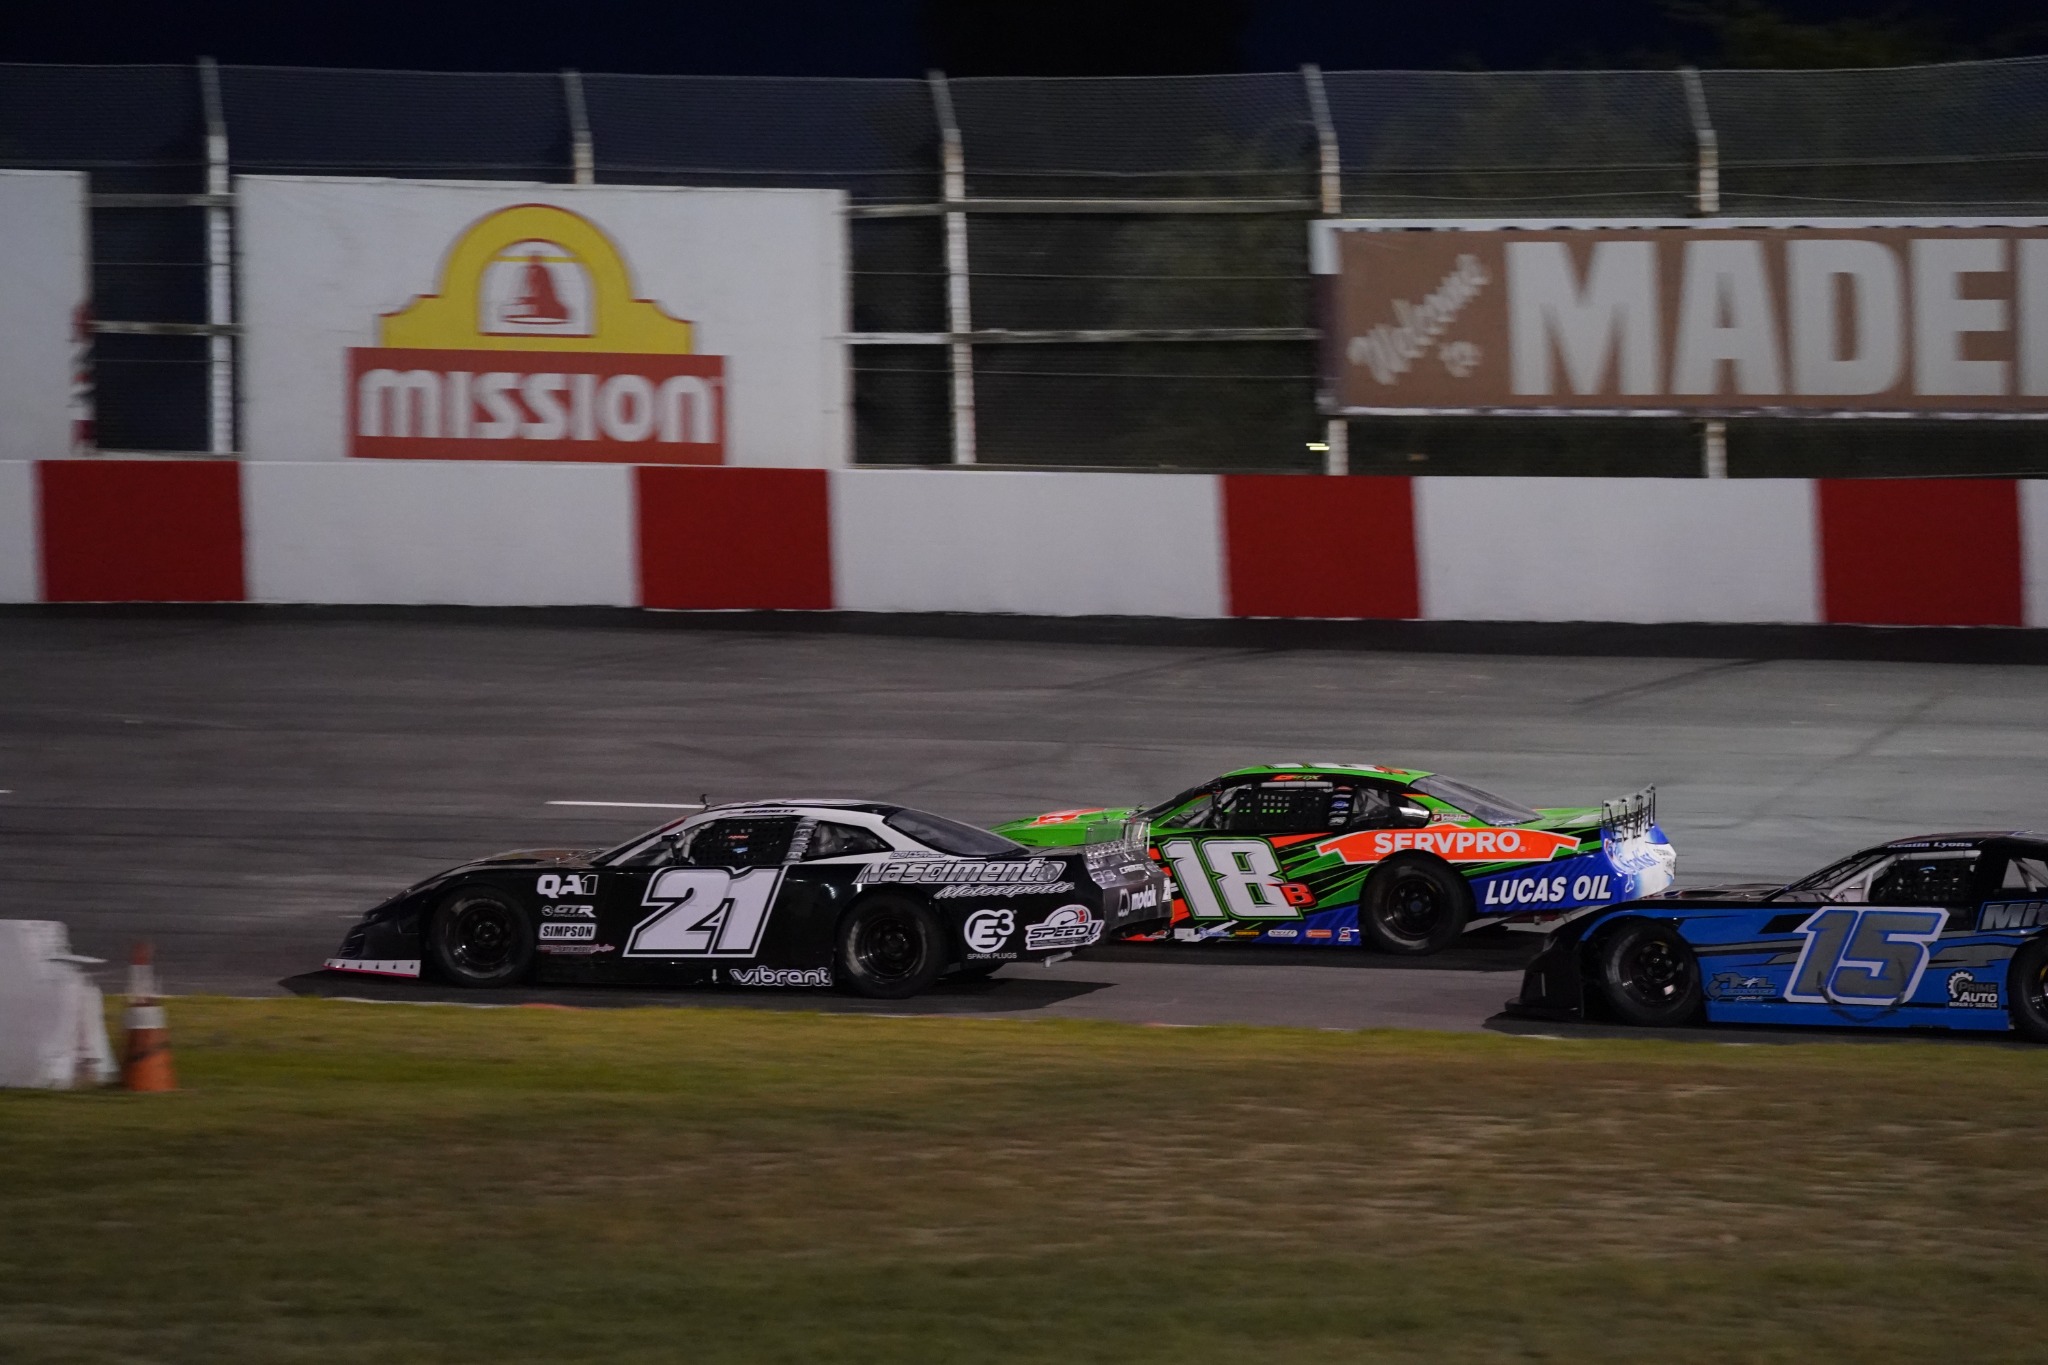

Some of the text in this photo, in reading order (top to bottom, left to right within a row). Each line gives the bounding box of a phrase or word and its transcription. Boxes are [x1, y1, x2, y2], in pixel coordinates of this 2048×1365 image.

[1374, 831, 1521, 854] SERVPRO
[1933, 841, 1973, 849] Lyons
[851, 858, 1067, 885] Nascimento
[1159, 838, 1303, 919] 18
[536, 874, 599, 899] QA1
[933, 881, 1075, 899] Motorsports
[1484, 874, 1612, 905] LUCAS OIL
[623, 866, 788, 958] 21
[542, 926, 593, 937] SIMPSON
[1785, 906, 1950, 1005] 15
[730, 965, 832, 986] vibrant
[1959, 991, 1998, 1003] AUTO
